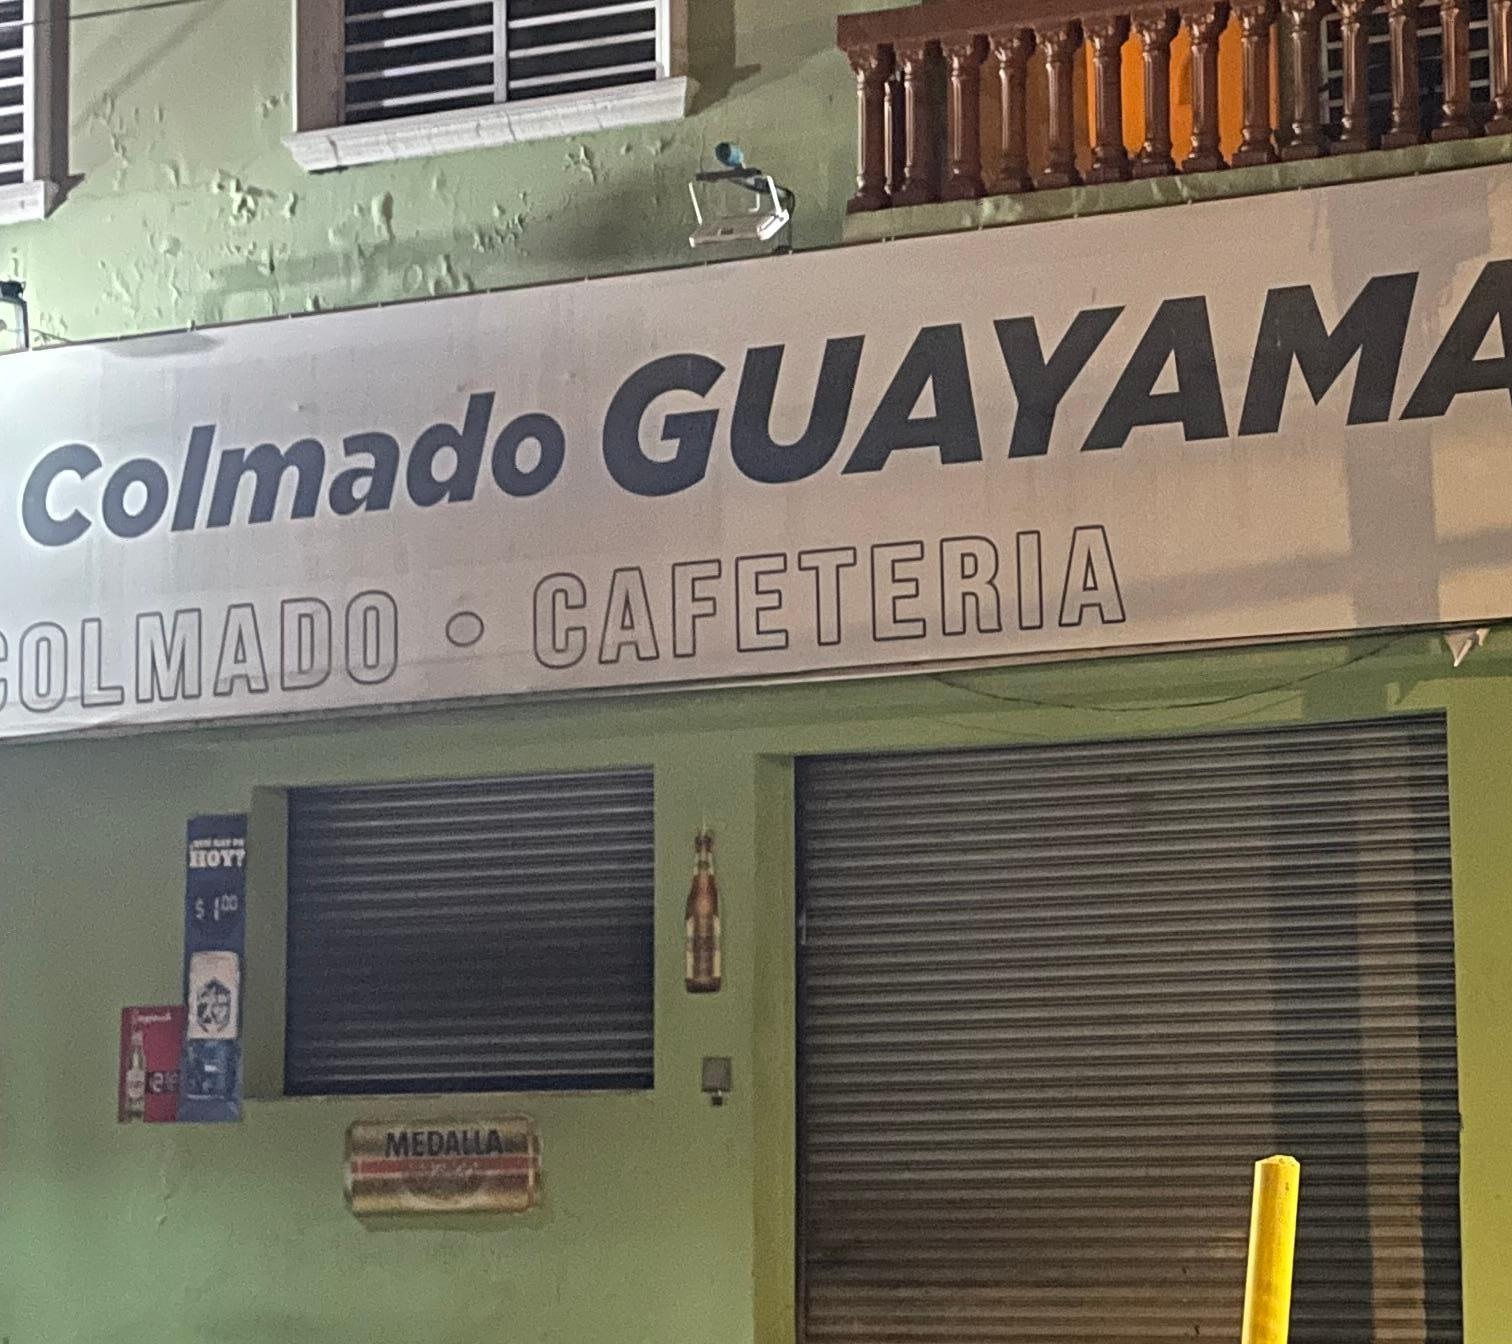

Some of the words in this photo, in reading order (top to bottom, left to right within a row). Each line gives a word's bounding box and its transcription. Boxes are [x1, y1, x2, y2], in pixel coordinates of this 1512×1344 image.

[21, 392, 566, 547] Colmado
[0, 590, 399, 714] OLMADO
[533, 524, 1127, 670] CAFETERIA
[384, 1128, 505, 1158] MEDALLA
